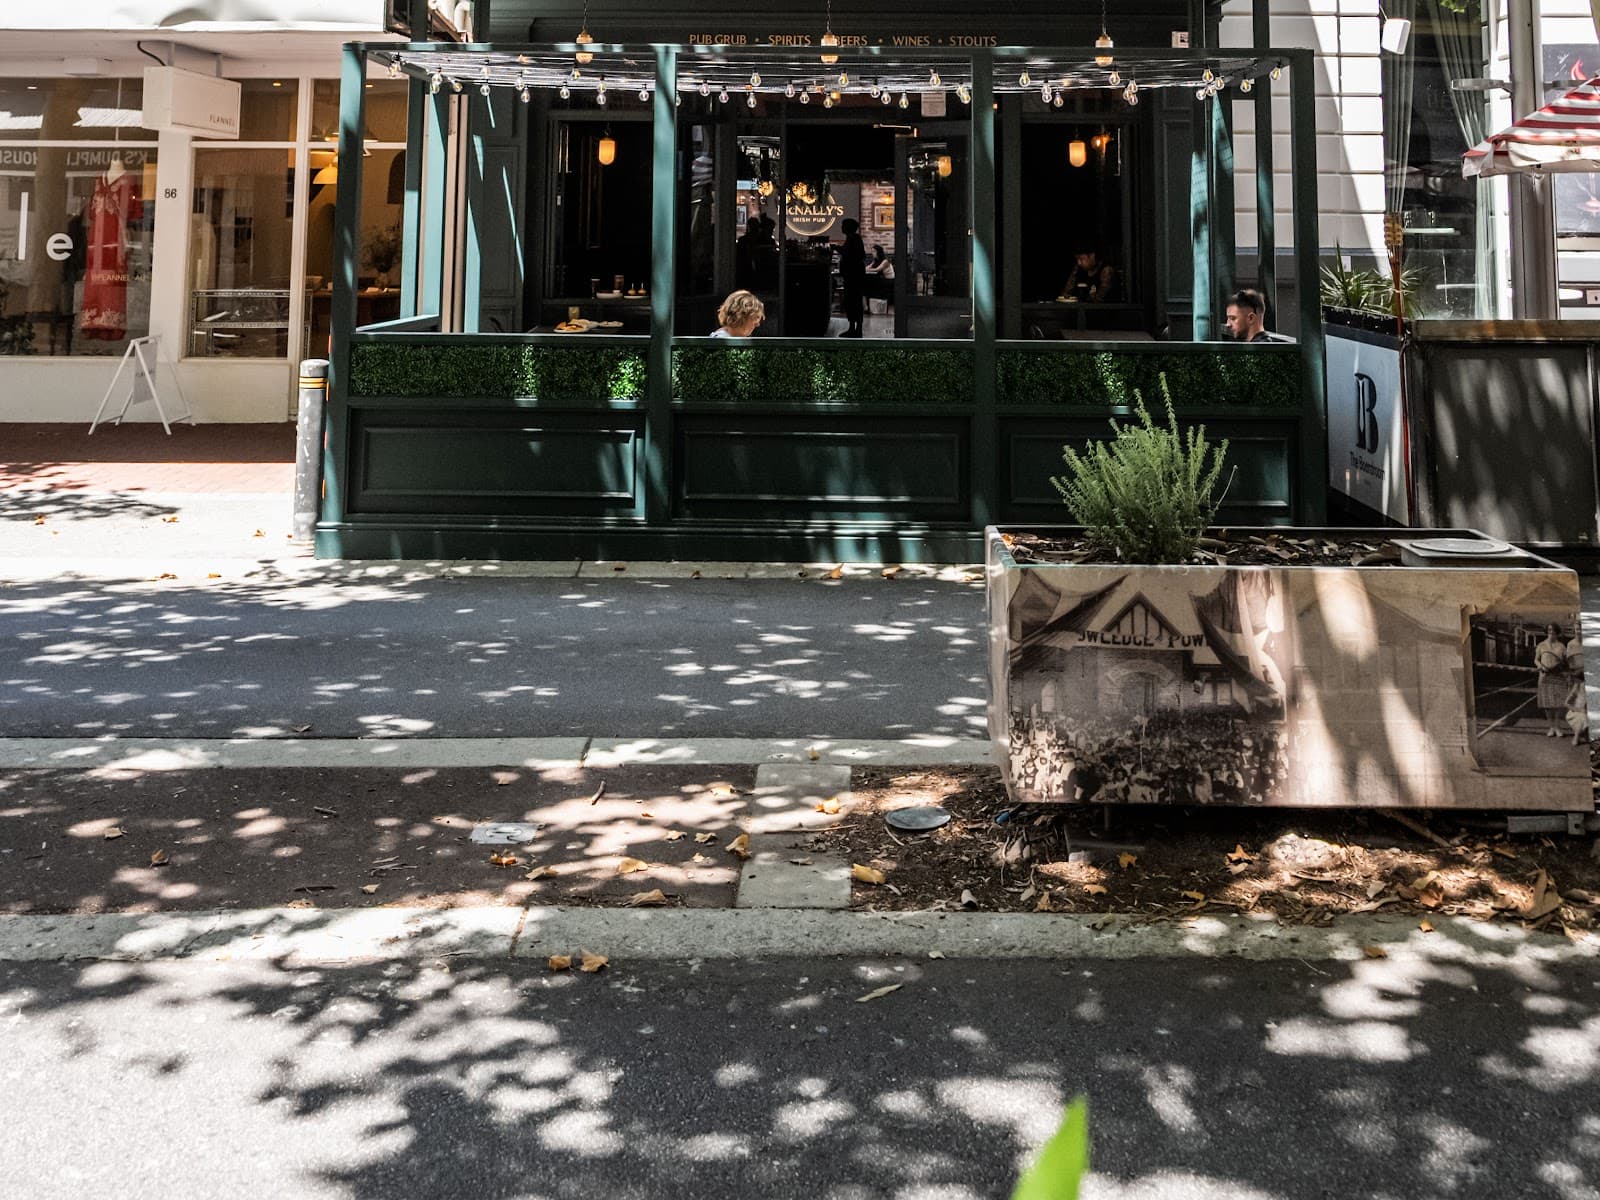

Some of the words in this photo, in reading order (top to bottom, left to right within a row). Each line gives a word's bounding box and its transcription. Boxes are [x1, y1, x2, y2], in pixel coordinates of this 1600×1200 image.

[689, 34, 713, 45] PUB
[714, 34, 747, 45] GRUB
[768, 34, 812, 46] SPIRITS
[892, 36, 931, 46] WINES
[949, 36, 998, 47] STOUTS
[209, 114, 236, 127] FLANNEL
[164, 188, 178, 199] 86
[1354, 373, 1379, 454] B
